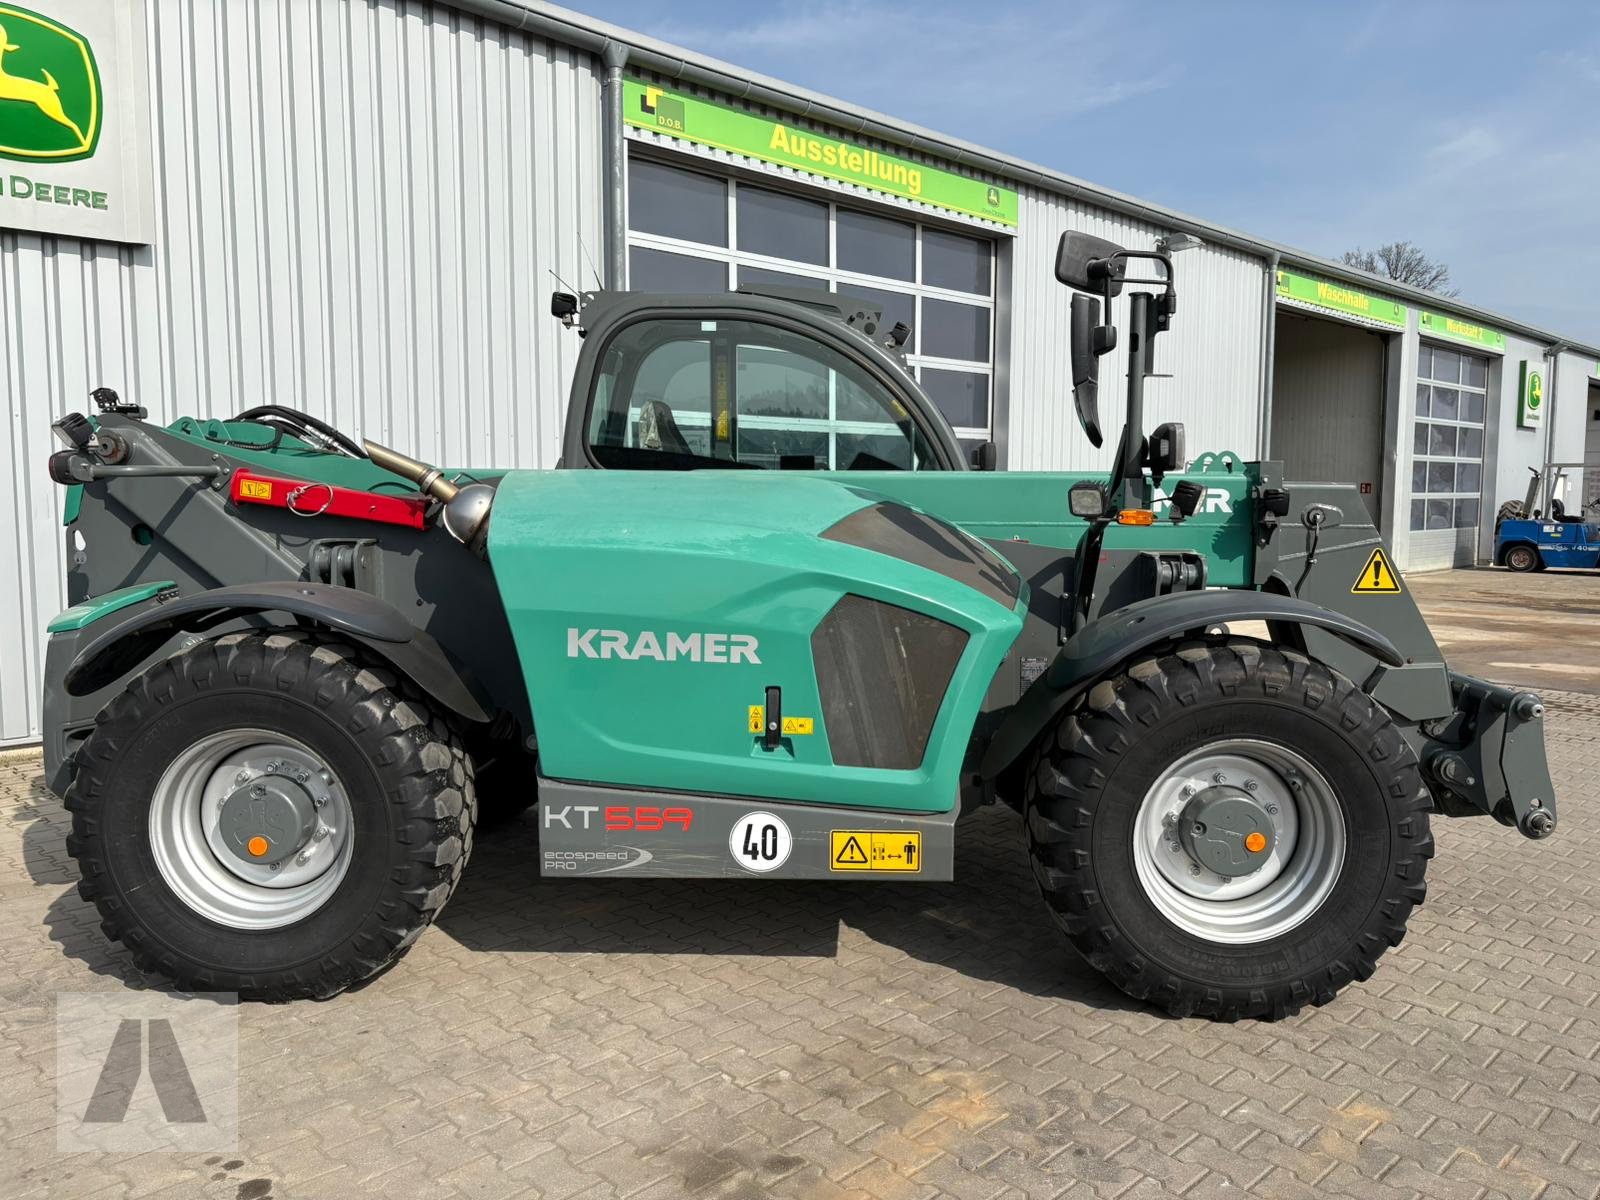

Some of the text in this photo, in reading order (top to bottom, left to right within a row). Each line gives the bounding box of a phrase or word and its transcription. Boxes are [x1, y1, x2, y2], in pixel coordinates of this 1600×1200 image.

[769, 123, 922, 195] Ausstellung
[9, 174, 109, 211] DEERE
[1317, 281, 1369, 310] Waschhalle
[567, 627, 763, 665] KRAMER
[544, 805, 694, 832] KT 559
[544, 850, 628, 862] ecospeed
[742, 823, 778, 861] 40
[544, 861, 577, 870] PRO
